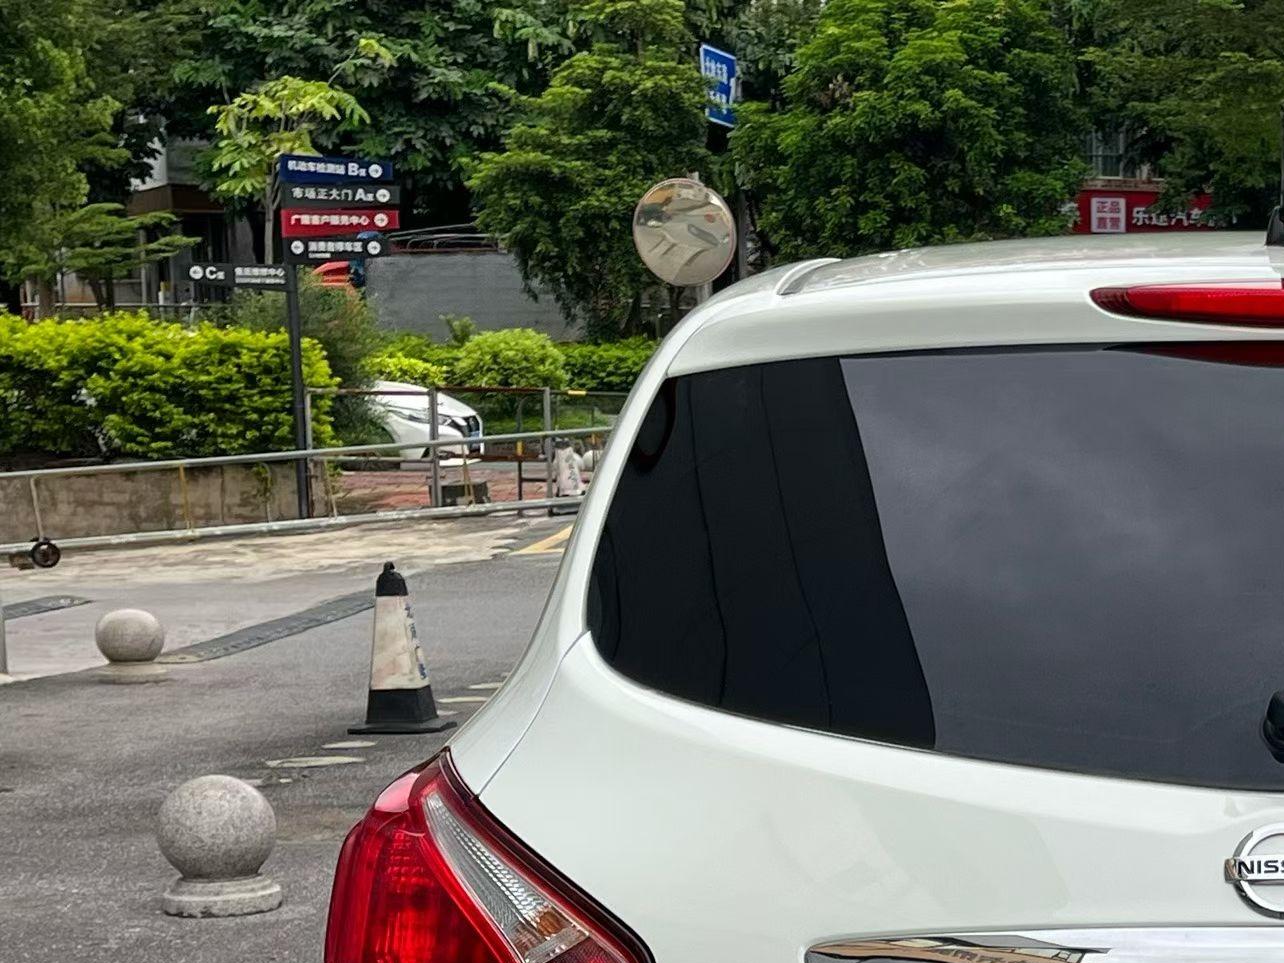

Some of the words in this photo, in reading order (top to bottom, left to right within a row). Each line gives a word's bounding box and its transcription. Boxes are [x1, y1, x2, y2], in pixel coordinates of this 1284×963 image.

[291, 187, 352, 201] 市场正大门
